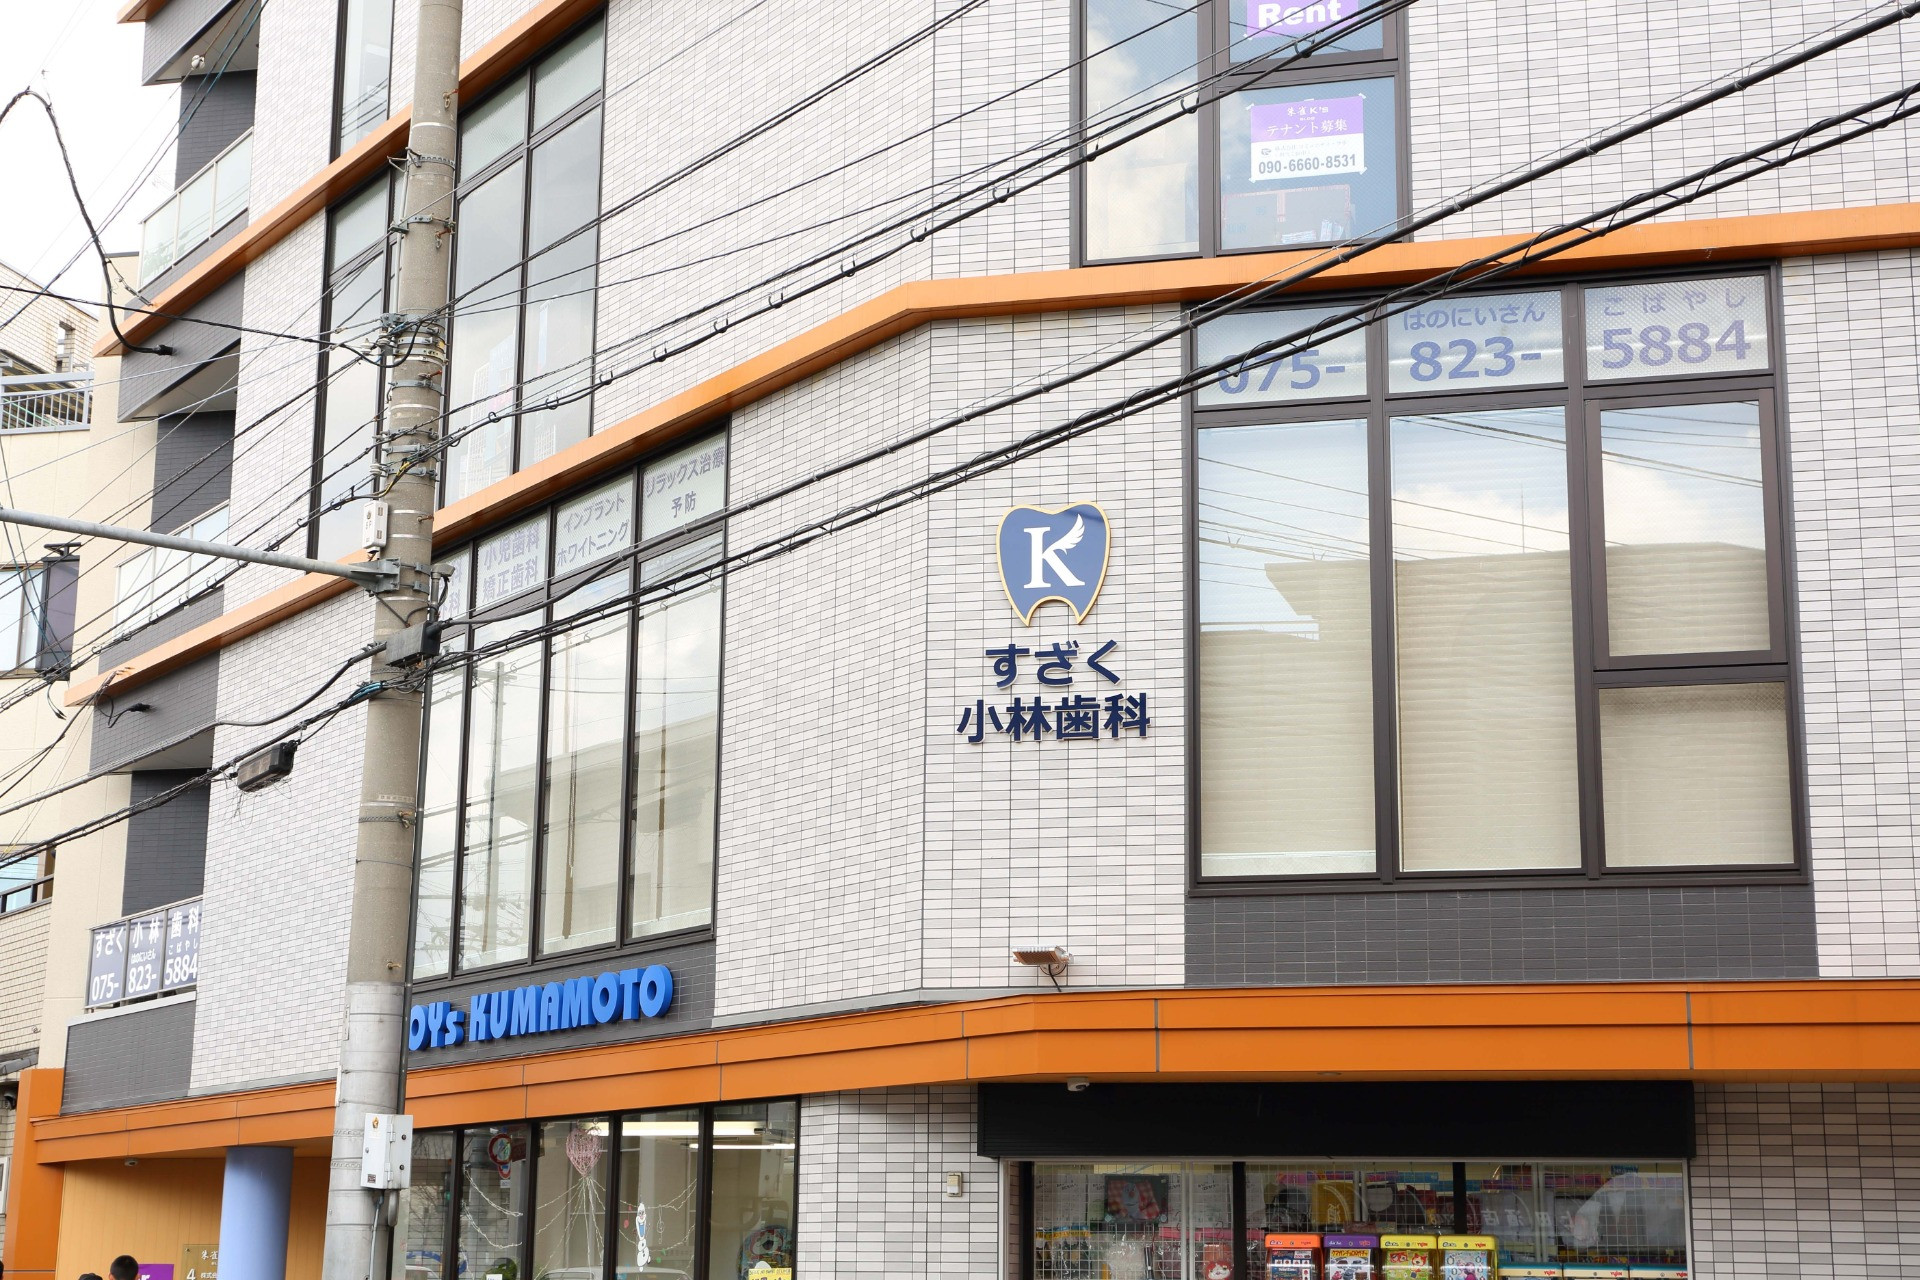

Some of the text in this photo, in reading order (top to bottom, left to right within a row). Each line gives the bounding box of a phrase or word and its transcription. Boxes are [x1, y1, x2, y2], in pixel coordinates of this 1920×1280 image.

[1258, 0, 1342, 28] Rent
[1266, 119, 1348, 137] テナント募集
[1258, 153, 1357, 175] 090-6660-8531
[1403, 302, 1546, 331] はのにいさん
[1408, 337, 1543, 382] 823-
[1601, 320, 1752, 370] 5884
[645, 447, 725, 499] リラックス治療
[562, 491, 626, 534] インプラント
[671, 491, 697, 519] 予防
[483, 522, 540, 571] 小児歯科
[556, 519, 631, 567] ホワイトニング
[1023, 513, 1086, 589] K
[482, 555, 539, 604] 矯正歯科
[985, 639, 1121, 689] すざく
[956, 692, 1151, 744] 小林歯科
[94, 905, 200, 959] すざく 小林 歯科
[91, 952, 199, 1002] 075- 823- 5884
[468, 964, 674, 1042] KUMAMOTO
[186, 1268, 196, 1280] 4
